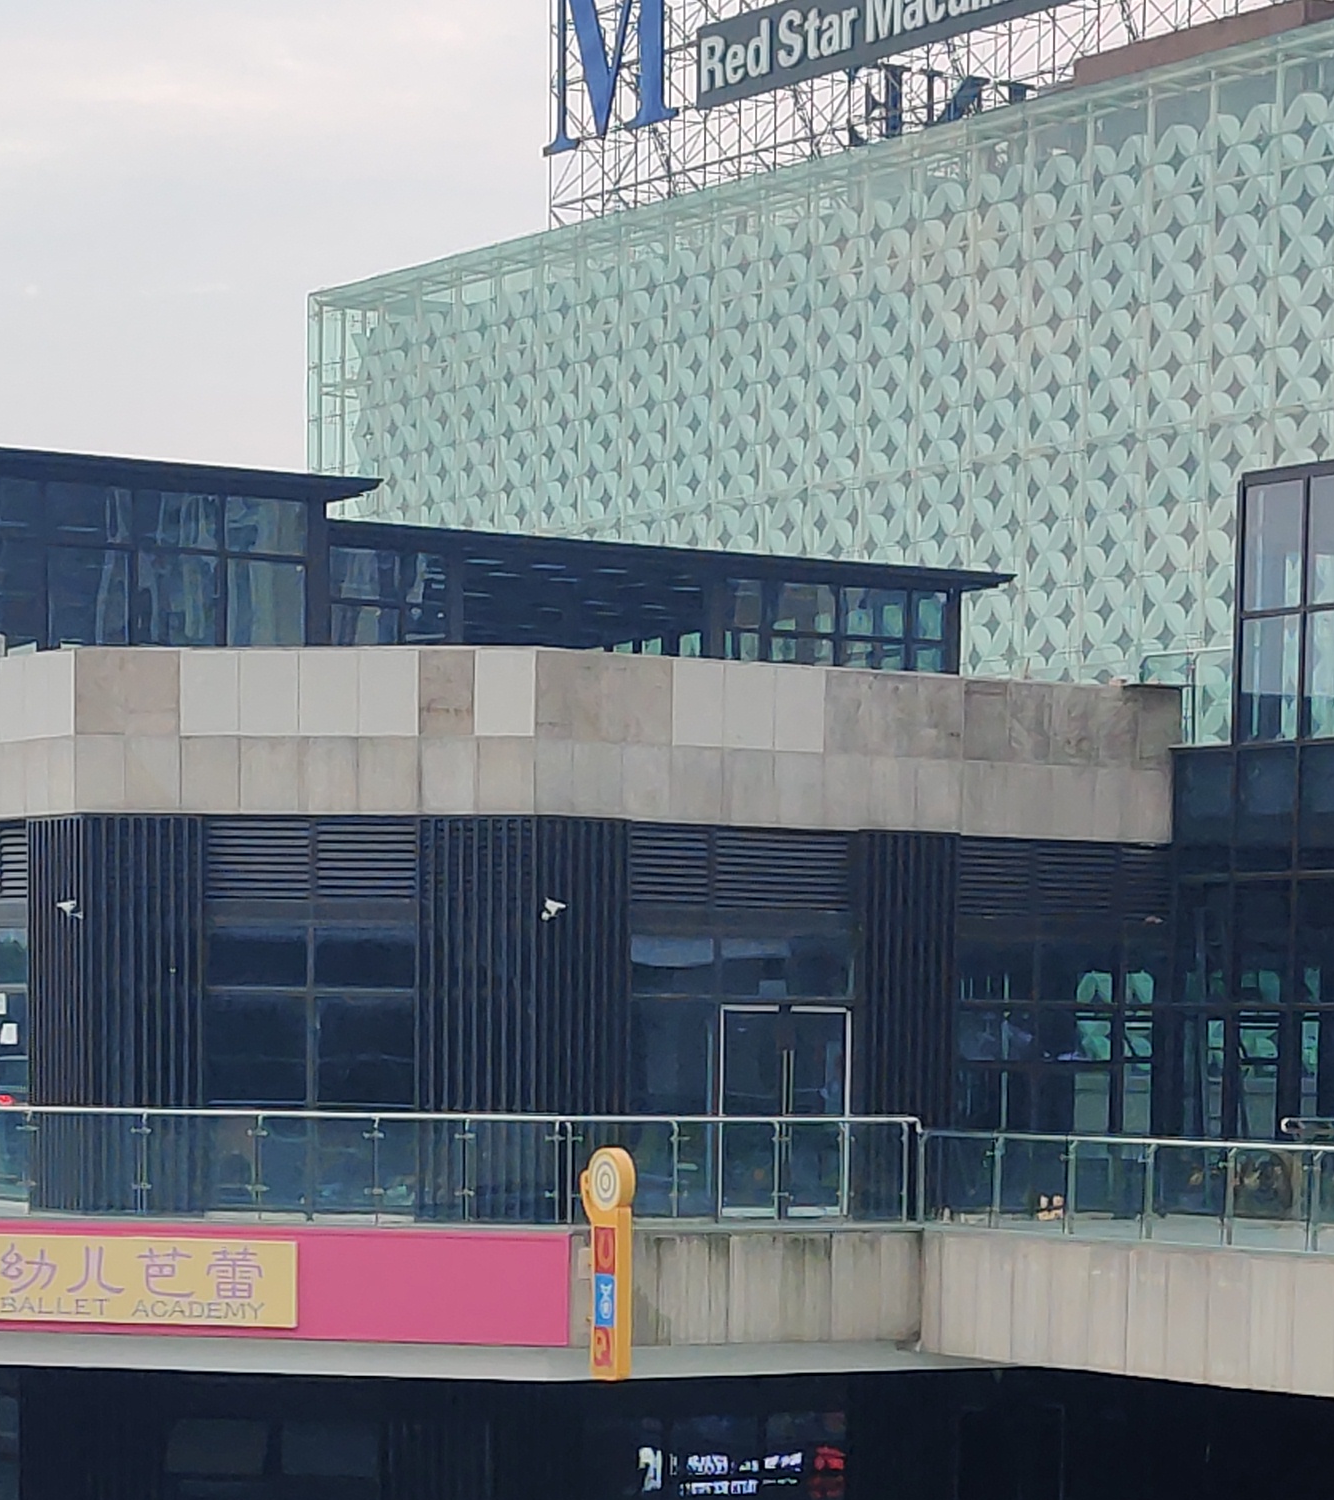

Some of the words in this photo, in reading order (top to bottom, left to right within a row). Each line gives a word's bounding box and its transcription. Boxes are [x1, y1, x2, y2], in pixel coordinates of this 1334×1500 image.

[700, 18, 772, 93] Red
[778, 7, 860, 68] Star
[1, 1243, 263, 1300] 幼儿芭蕾
[0, 1296, 109, 1317] BALLET
[131, 1299, 265, 1321] ACADEMY
